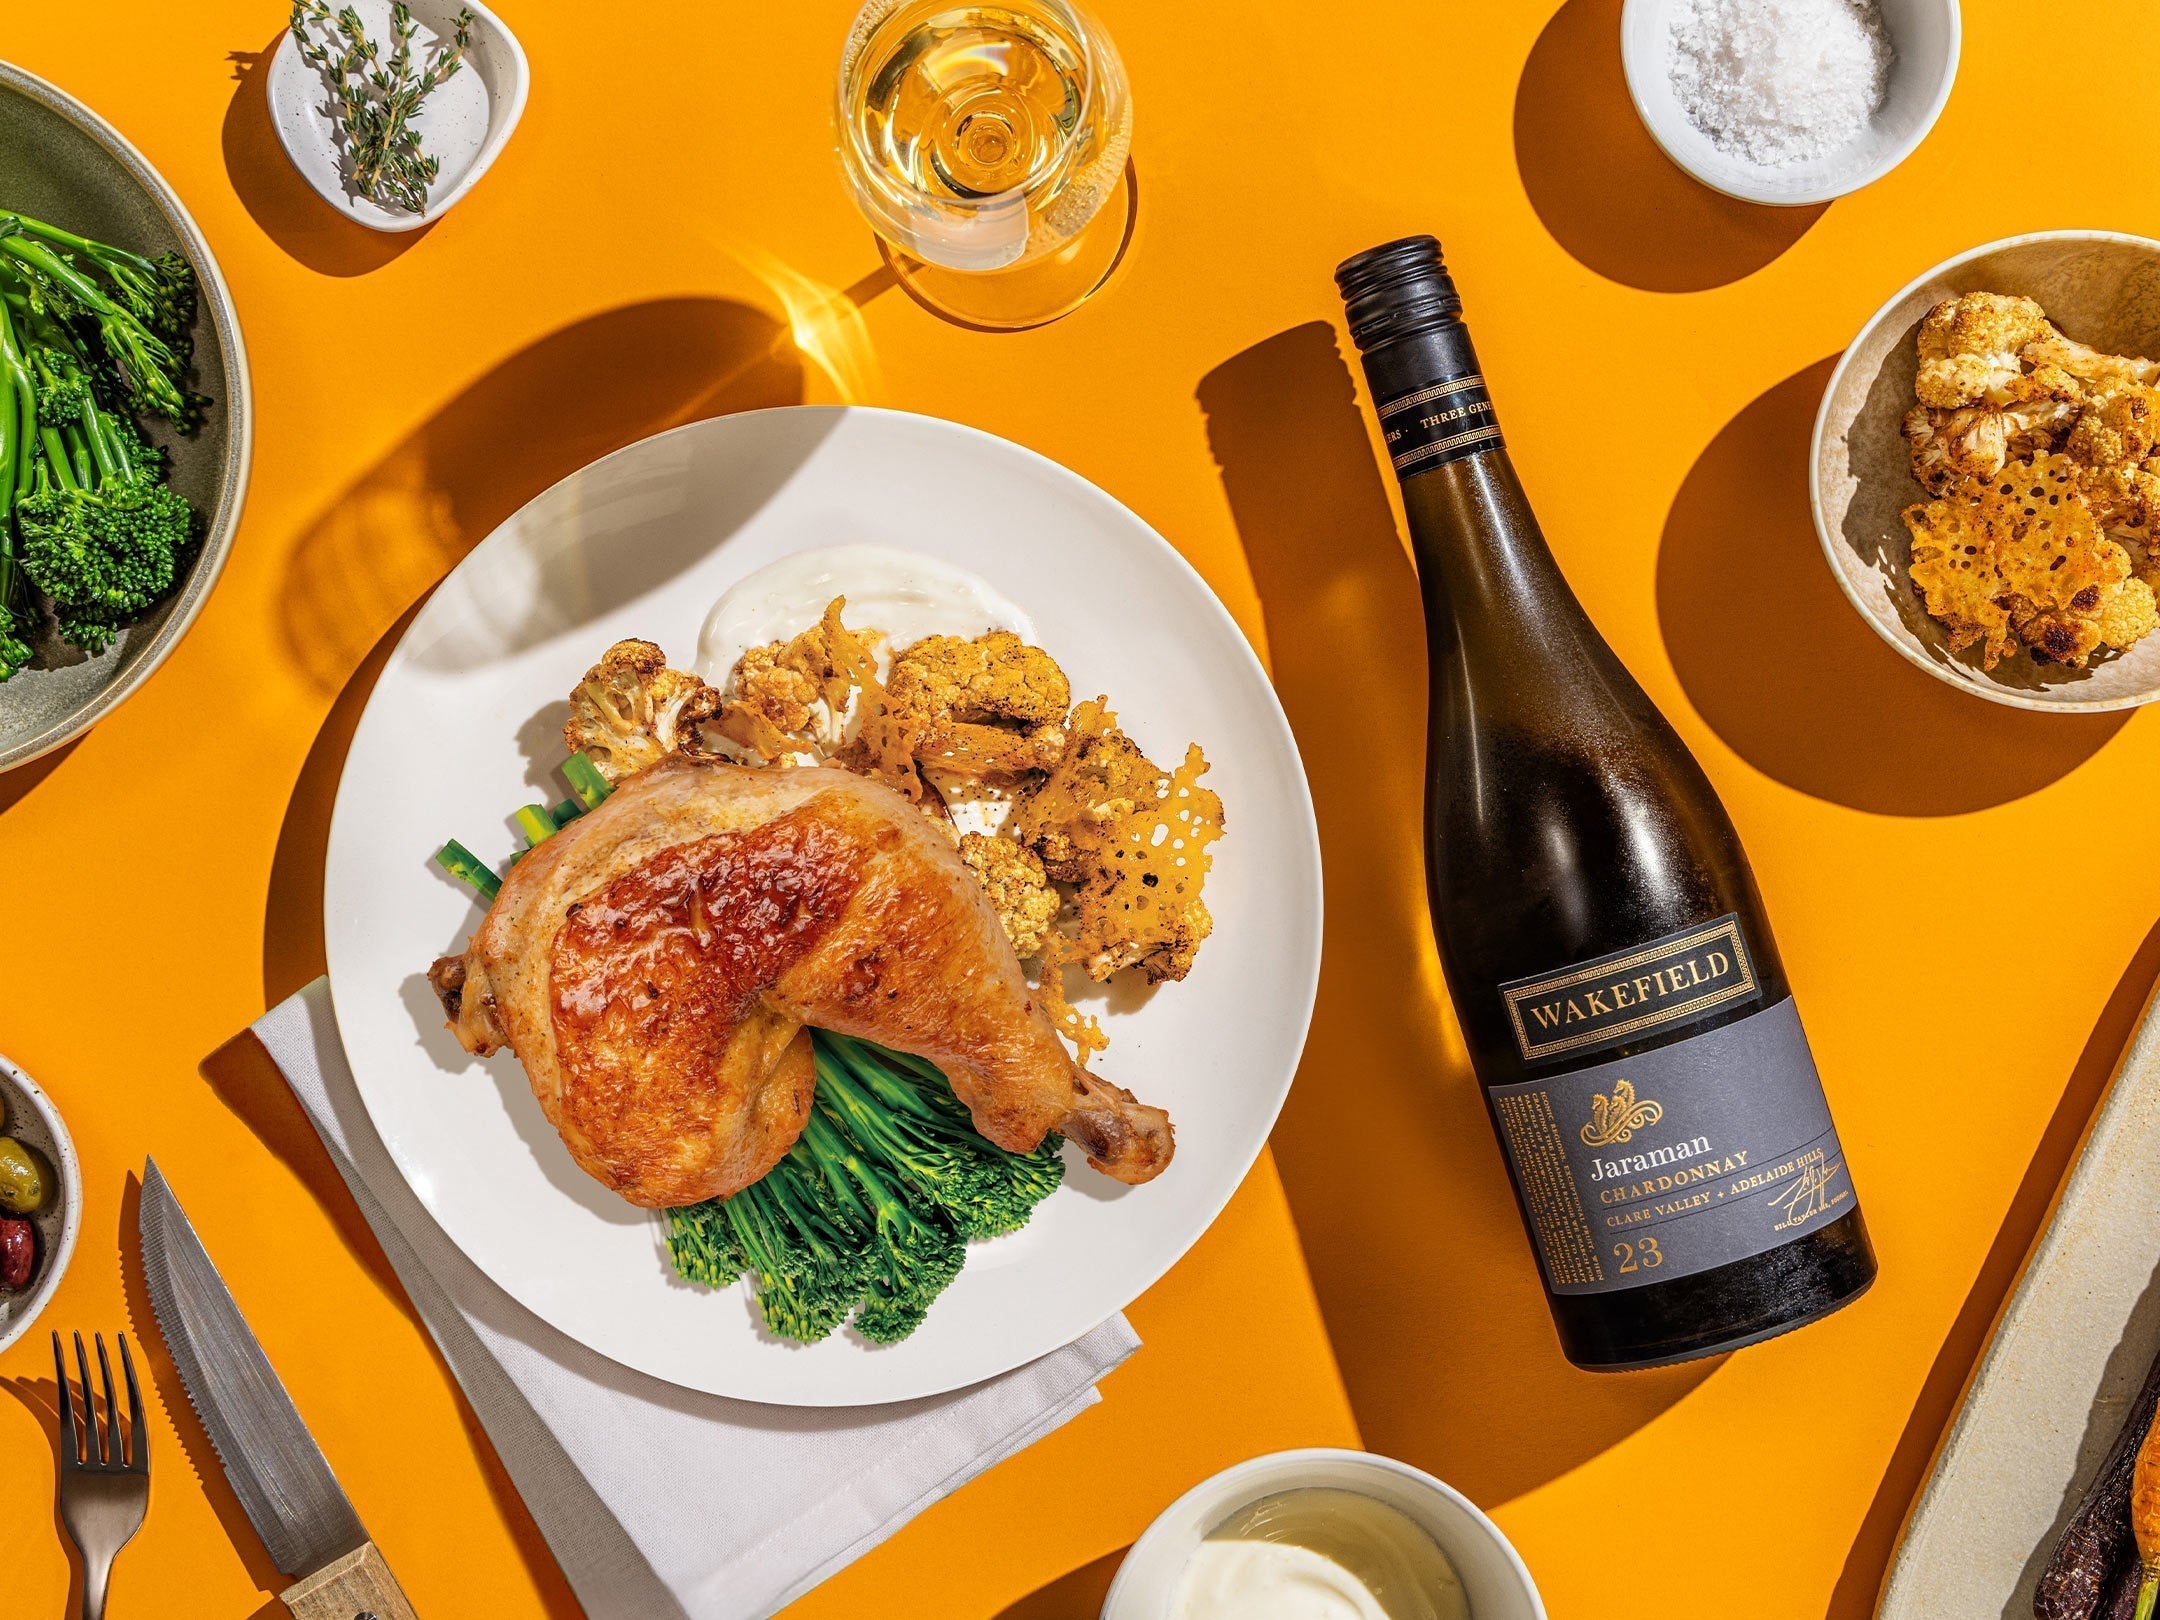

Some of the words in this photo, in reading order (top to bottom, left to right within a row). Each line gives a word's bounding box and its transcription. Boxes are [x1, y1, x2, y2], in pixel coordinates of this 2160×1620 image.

[1386, 429, 1402, 444] ERS
[1420, 407, 1466, 429] THREE
[1469, 401, 1493, 414] GENE
[1531, 951, 1730, 1030] WAKEFIELD
[1531, 1093, 1549, 1132] CRAFTING
[1550, 1152, 1566, 1188] JARAMAN
[1562, 1191, 1575, 1217] RANGE
[1575, 1234, 1589, 1264] SEARCH
[1540, 1091, 1554, 1120] ICONIC
[1550, 1123, 1567, 1161] REGIONS.
[1563, 1165, 1586, 1221] EXCEPTIONAL
[1581, 1225, 1595, 1251] FRUIT.
[1591, 1255, 1604, 1281] WHEN
[1591, 1136, 1712, 1182] Jaraman
[1600, 1150, 1749, 1204] CHARDONNAY
[1606, 1203, 1652, 1228] CLARE
[1655, 1191, 1711, 1216] VALLEY
[1730, 1161, 1795, 1195] ADELAIDE
[1796, 1147, 1822, 1168] HILLS
[1774, 1220, 1792, 1231] BILL
[1792, 1209, 1818, 1223] TAYLOR
[1613, 1236, 1664, 1274] 23
